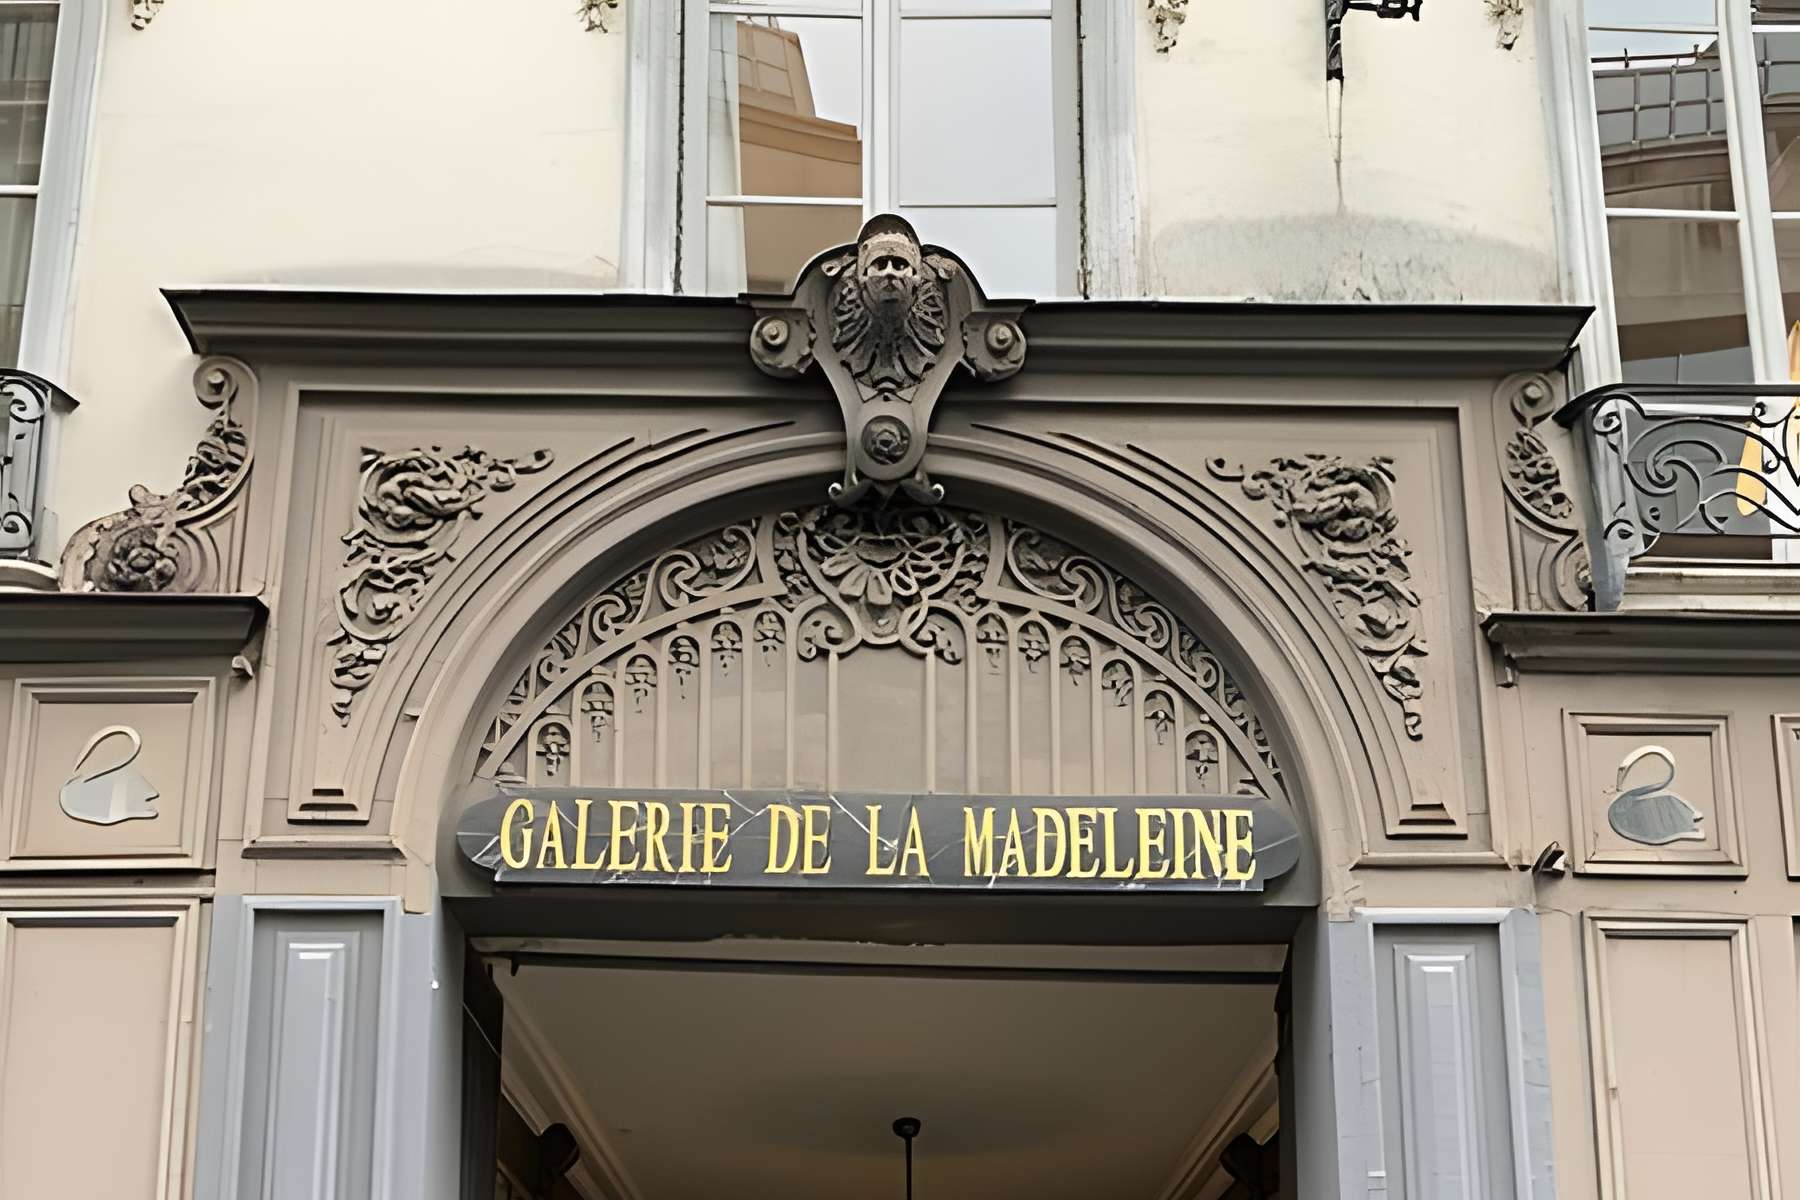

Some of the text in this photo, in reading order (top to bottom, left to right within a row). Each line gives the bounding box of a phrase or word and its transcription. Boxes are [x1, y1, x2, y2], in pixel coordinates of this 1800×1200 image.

[500, 798, 1256, 881] GALERIE DE LA MADELEINE
